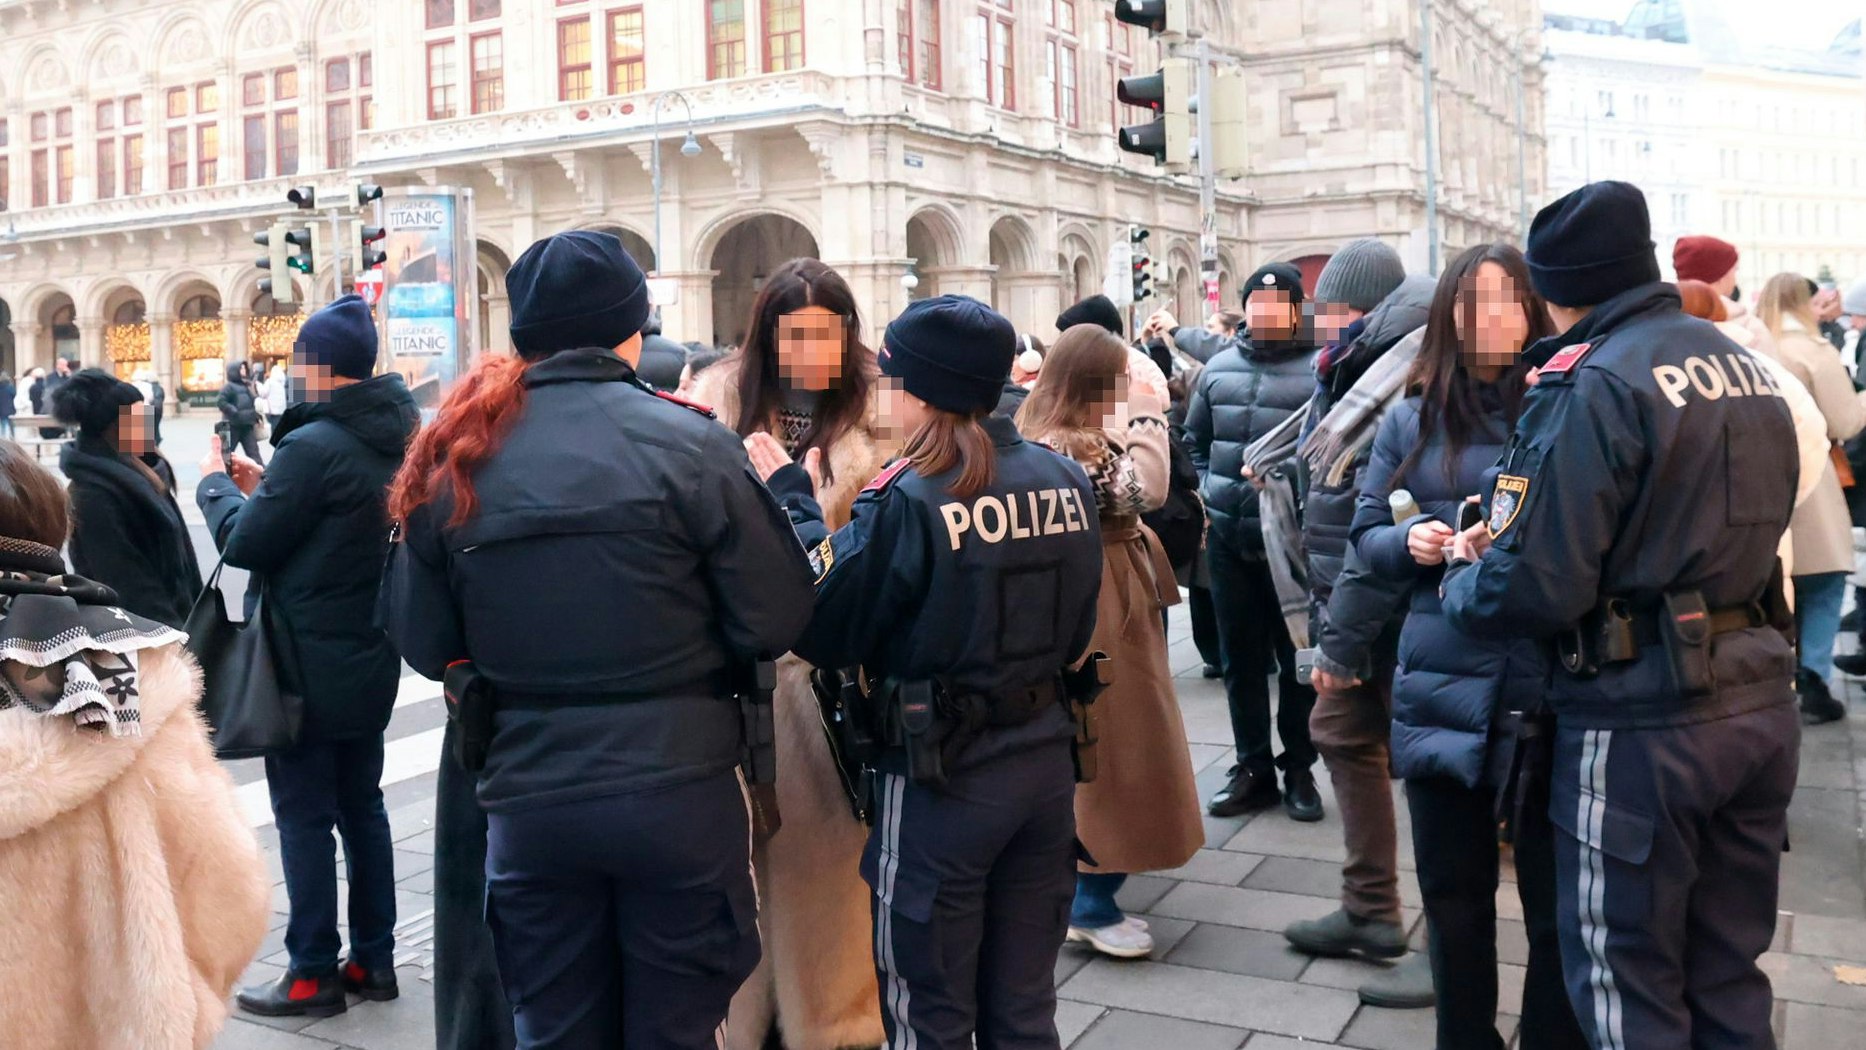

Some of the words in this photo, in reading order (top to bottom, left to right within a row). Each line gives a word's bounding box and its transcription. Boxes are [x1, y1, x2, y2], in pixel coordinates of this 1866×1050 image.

[390, 211, 443, 225] TITANIC
[392, 336, 447, 350] TITANIC
[1652, 353, 1783, 408] POLIZE
[939, 488, 1089, 551] POLIZEI
